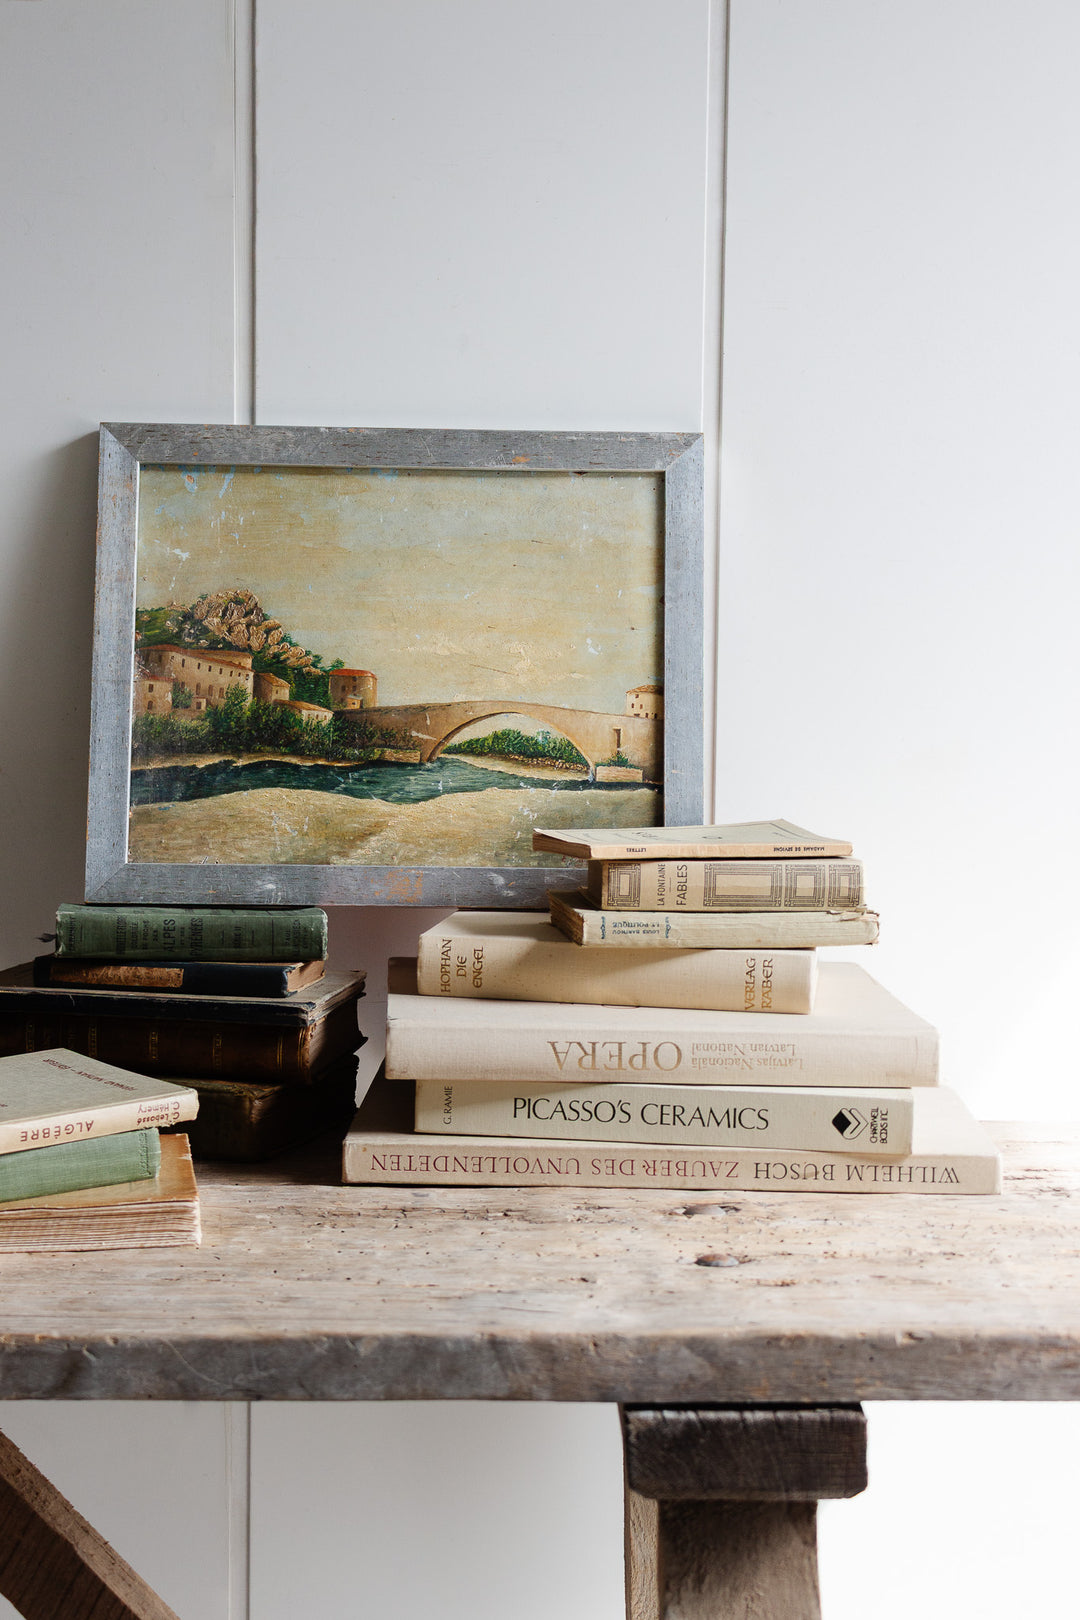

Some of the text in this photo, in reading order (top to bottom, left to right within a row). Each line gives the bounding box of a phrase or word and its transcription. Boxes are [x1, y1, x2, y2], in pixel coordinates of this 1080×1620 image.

[657, 863, 665, 906] LA FONTAINE
[676, 864, 689, 906] FABLES
[163, 918, 176, 952] ALPES
[612, 921, 648, 929] POLITIQUE
[441, 939, 452, 993] HOPHAN
[456, 956, 467, 978] DIE
[472, 946, 484, 988] ENGEL
[745, 958, 756, 1010] VERLAG
[548, 1041, 682, 1071] OPERA
[691, 1043, 796, 1055] Latvian National
[756, 1056, 803, 1070] Latvijas
[137, 1112, 169, 1125] Lebossé
[138, 1103, 170, 1114] Hémery
[443, 1086, 452, 1125] G. RAMIE
[513, 1097, 769, 1130] PICASSO'S CERAMICS
[20, 1120, 94, 1142] ALGÈBRE
[870, 1107, 879, 1143] CHARTWELL
[879, 1122, 888, 1143] BOOKS
[370, 1154, 739, 1178] ZAUBER DES UNVOLLENDETEN
[754, 1162, 961, 1184] WILHELM BUSCH
